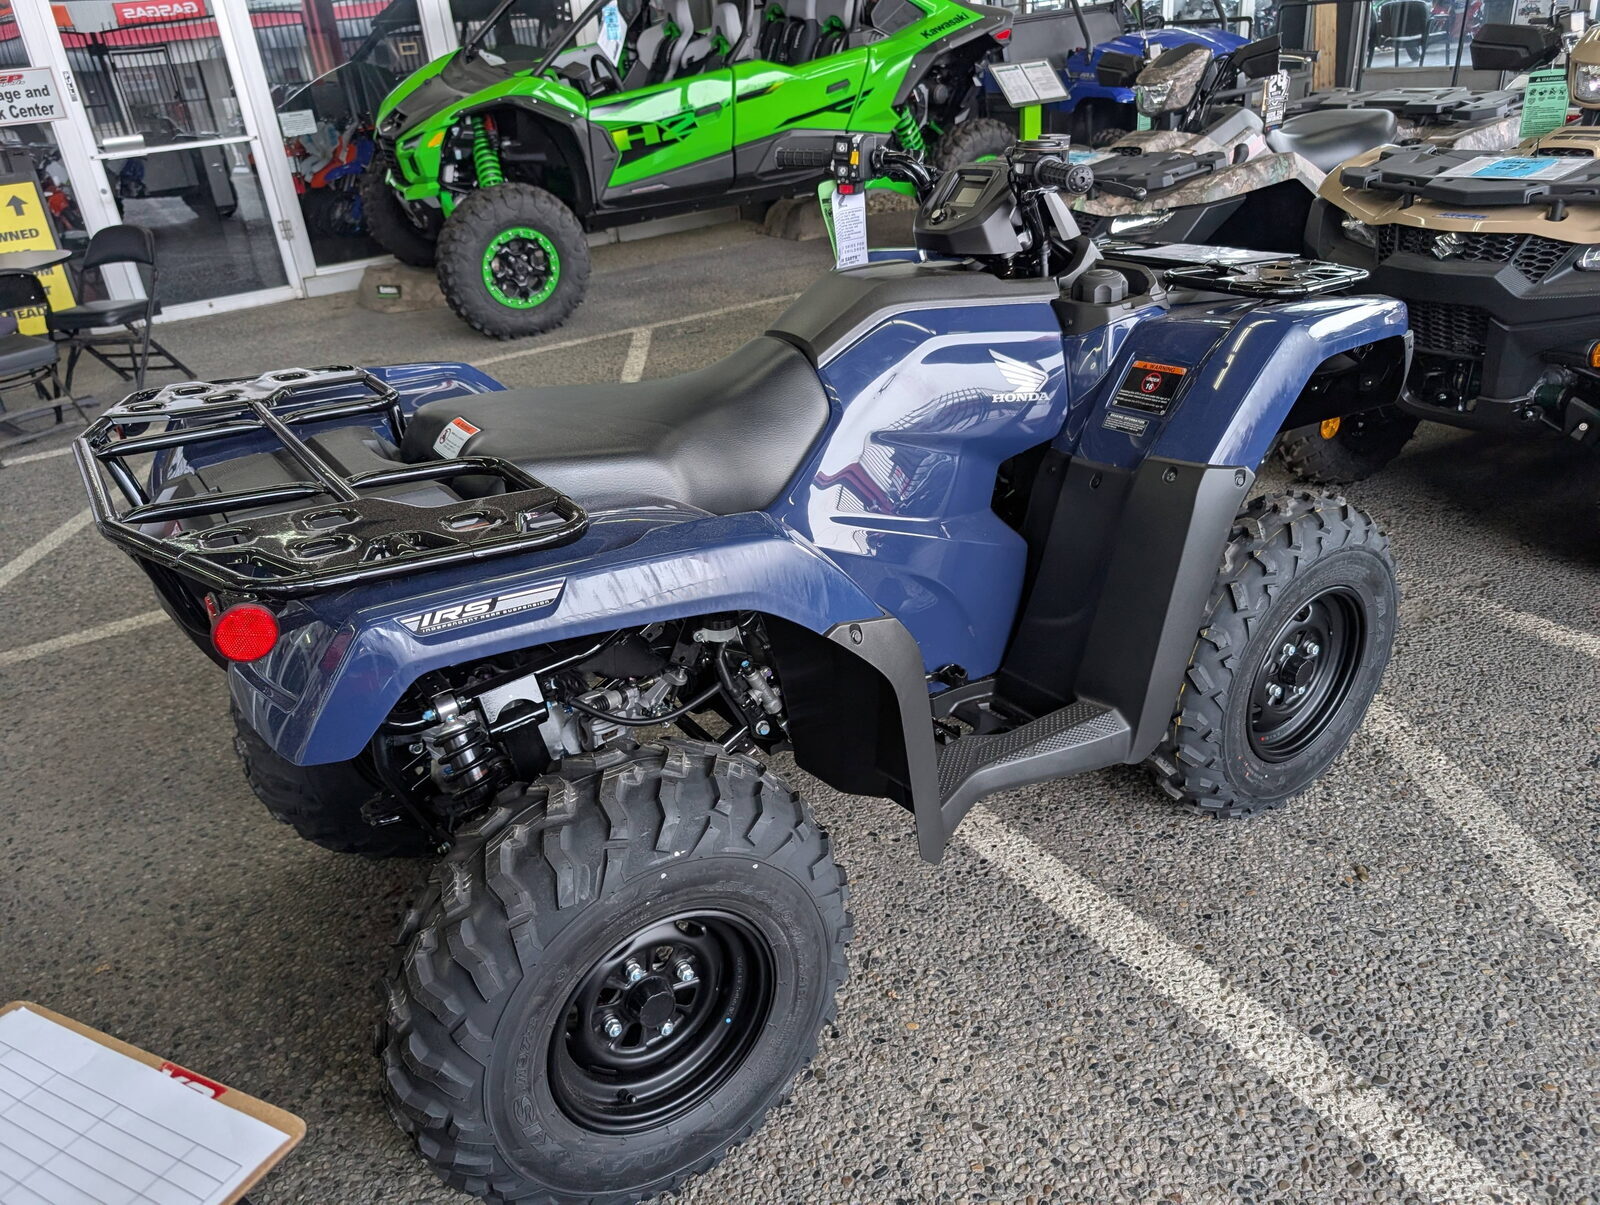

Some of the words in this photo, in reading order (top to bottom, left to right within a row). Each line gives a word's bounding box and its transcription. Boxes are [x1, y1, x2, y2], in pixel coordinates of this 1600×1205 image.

[920, 11, 970, 39] Kawasaki
[25, 84, 51, 98] and
[9, 102, 55, 119] Center
[991, 392, 1050, 403] HONDA
[420, 598, 493, 627] IRS
[422, 617, 479, 633] INDEPENDENT
[480, 611, 501, 620] REAR
[502, 600, 551, 614] SUSPENSION
